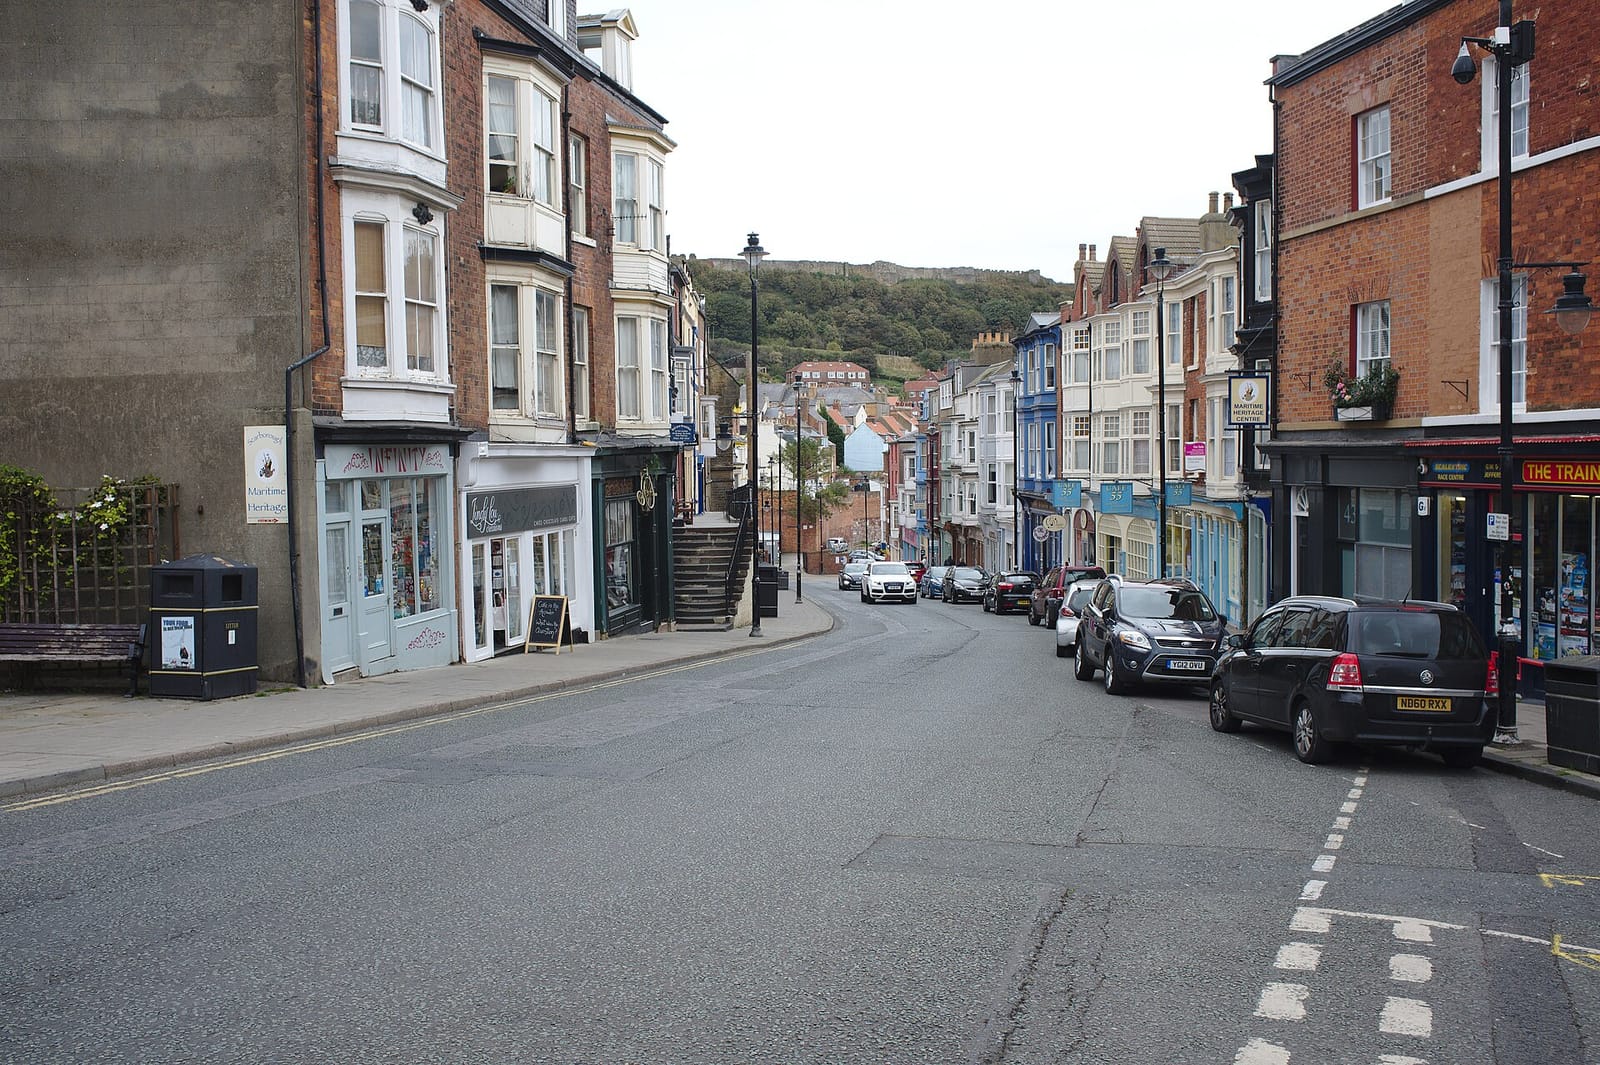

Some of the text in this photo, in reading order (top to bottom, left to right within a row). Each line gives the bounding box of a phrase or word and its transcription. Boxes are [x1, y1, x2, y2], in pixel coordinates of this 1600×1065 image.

[248, 432, 283, 446] Scarborough
[368, 448, 426, 473] INFINITY
[1527, 464, 1600, 481] THE TRAIN
[248, 487, 286, 496] Maritime
[1110, 492, 1122, 500] 55
[248, 503, 286, 514] Heritage
[1344, 504, 1355, 524] 43
[1428, 700, 1447, 709] RXX
